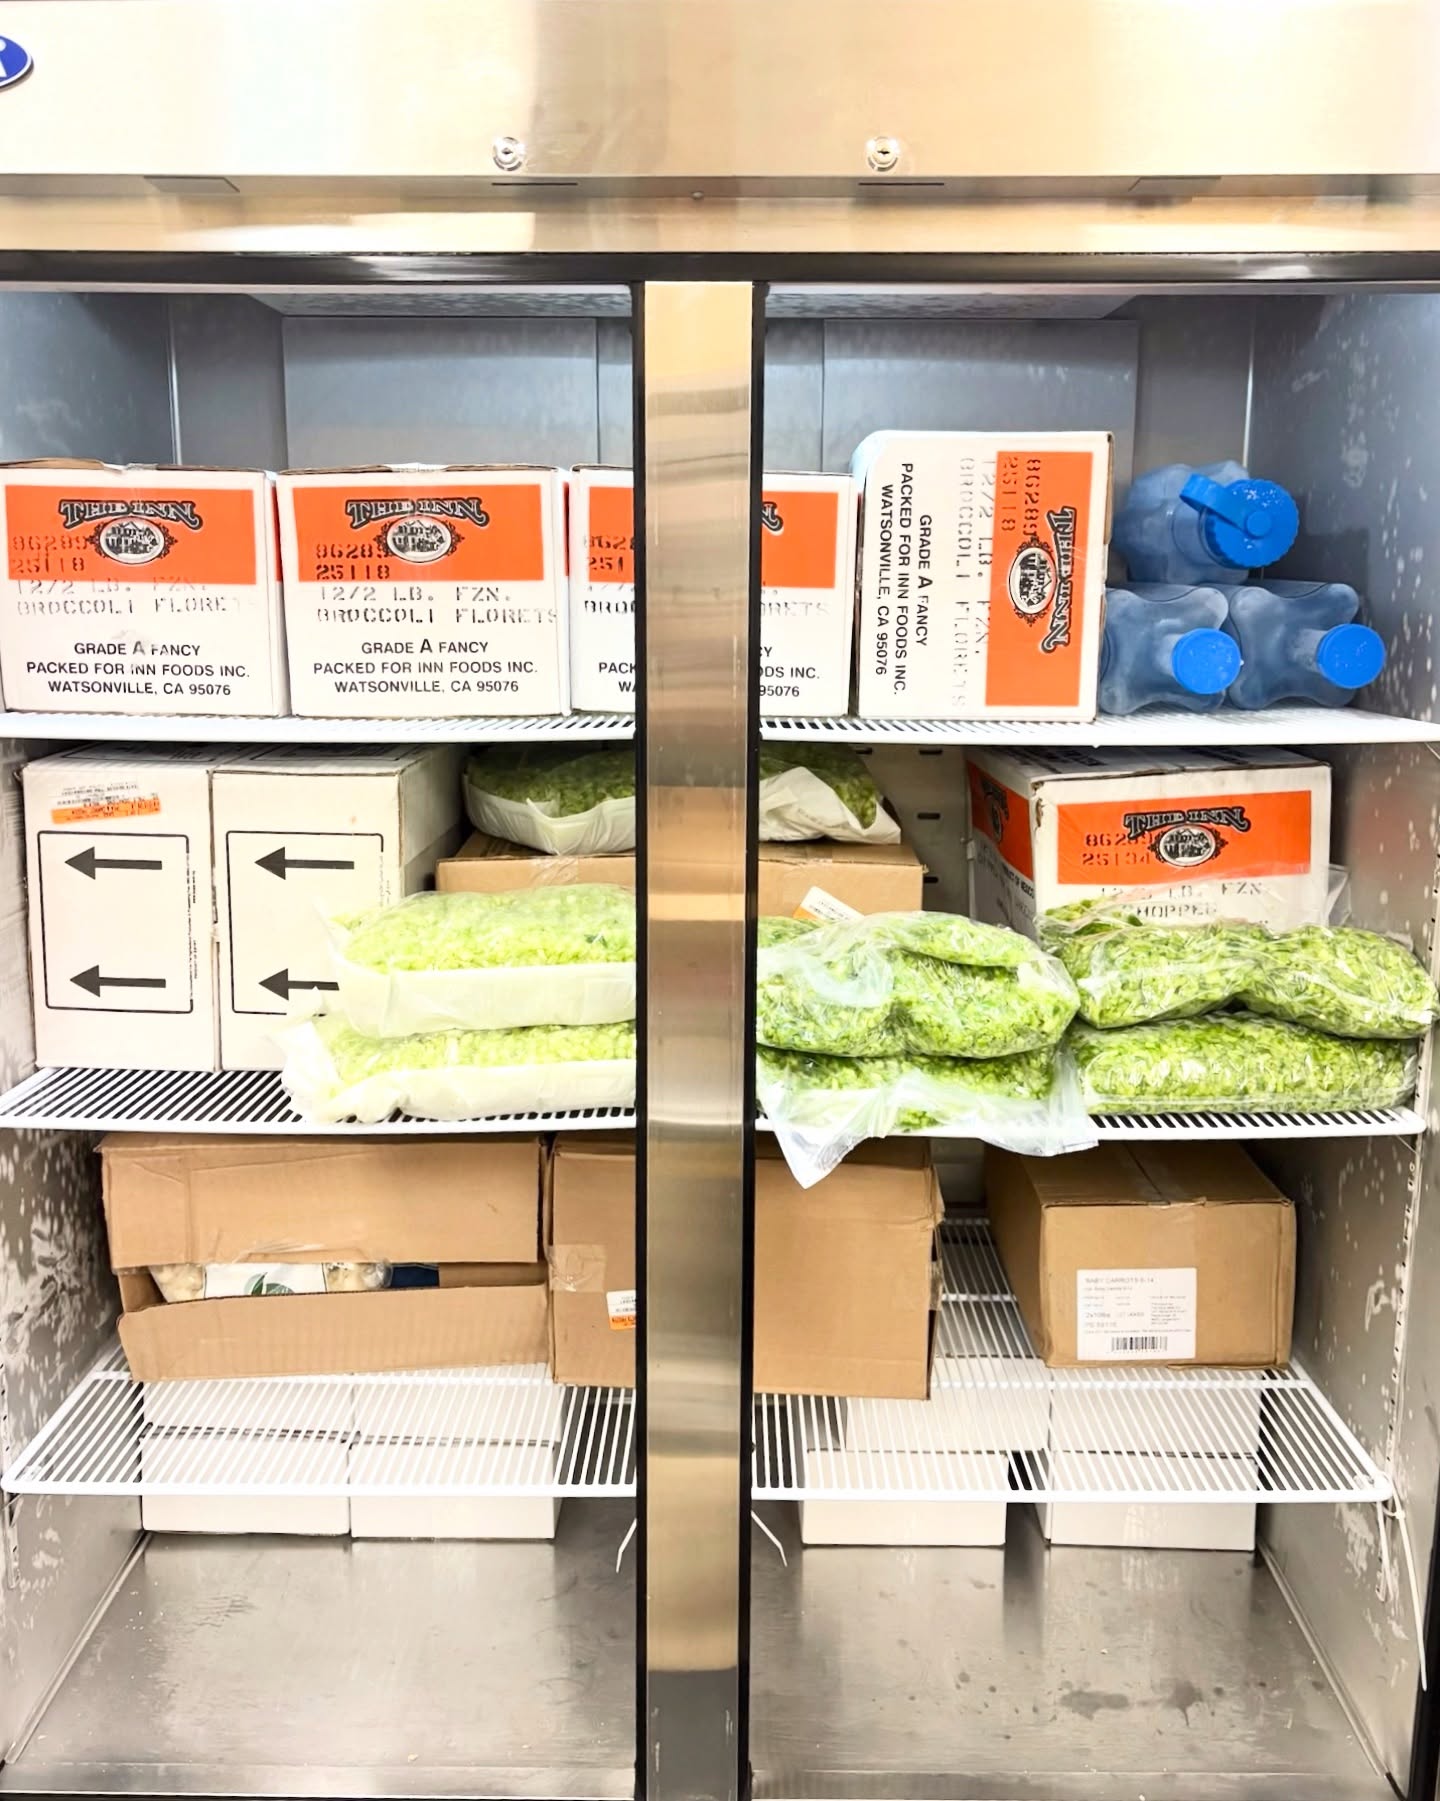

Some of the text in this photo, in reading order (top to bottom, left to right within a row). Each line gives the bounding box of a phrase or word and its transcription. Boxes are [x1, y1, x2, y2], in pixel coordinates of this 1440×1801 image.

[59, 499, 203, 530] THE INN
[345, 497, 490, 529] THE INN
[316, 564, 390, 580] 25118
[876, 484, 893, 675] WATSONVILLE, CA 95076
[894, 463, 913, 694] PACKED FOR INN FOODS INC.
[1041, 506, 1077, 653] THE INN
[915, 514, 933, 647] GRADE A FANCY
[317, 608, 433, 623] BROCCOLI
[74, 641, 201, 656] GRADE A FANCY
[361, 638, 489, 654] GRADE A FANCY
[27, 662, 250, 678] PACKED FOR INN FOODS INC.
[314, 661, 538, 675] PACKED FOR INN FOODS INC.
[791, 666, 820, 679] INC.
[48, 681, 231, 696] WATSONVILLE, CA 95076
[335, 680, 519, 695] WATSONVILLE, CA 95076
[760, 685, 800, 697] 95076
[1124, 806, 1252, 840] THE INN
